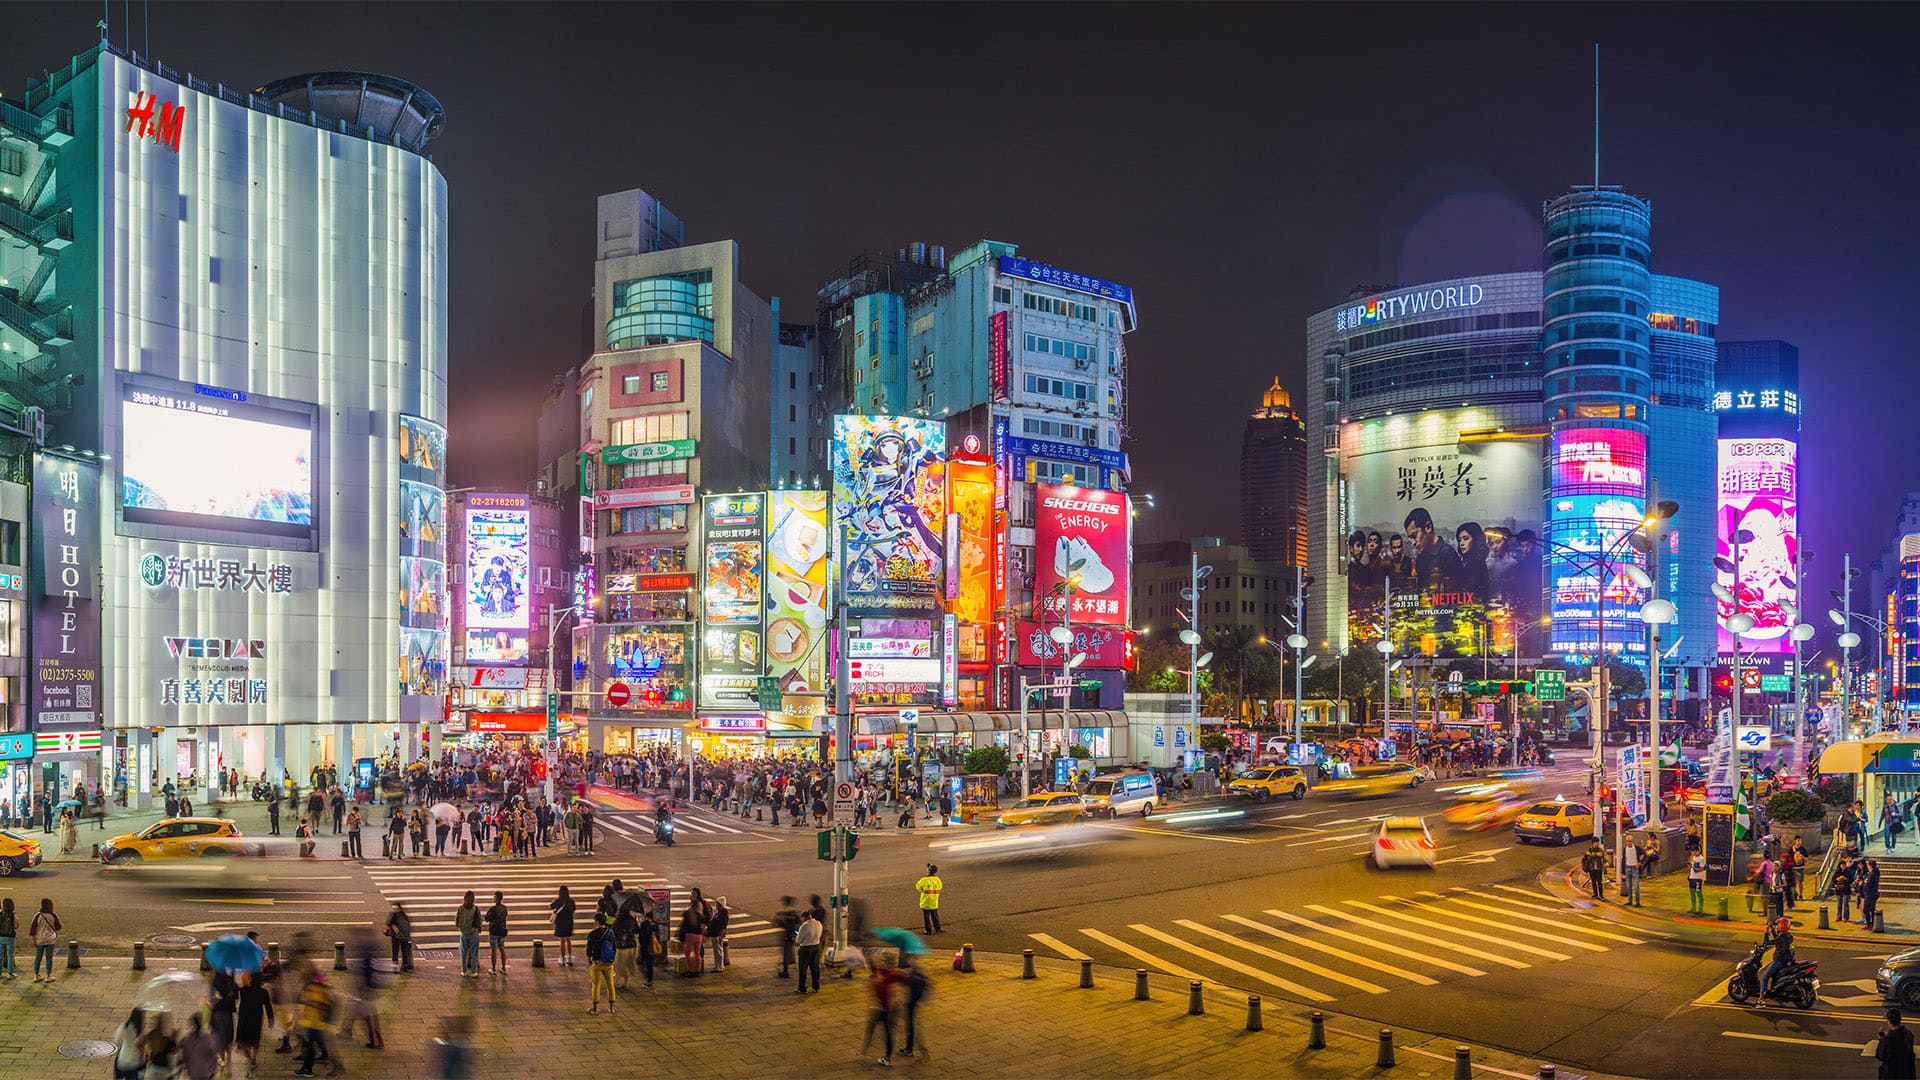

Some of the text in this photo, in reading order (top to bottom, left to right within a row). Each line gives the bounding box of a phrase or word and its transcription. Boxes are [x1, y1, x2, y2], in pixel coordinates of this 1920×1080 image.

[127, 90, 185, 153] H&M
[1042, 266, 1100, 290] 台北天禾旅店
[195, 383, 248, 402] Panasonic
[1713, 389, 1780, 410] 德立莊
[175, 400, 197, 412] 11.8
[1041, 443, 1090, 458] 台北天禾旅店
[1408, 456, 1434, 464] NETFLIX
[1396, 461, 1474, 502] 罪夢者
[59, 470, 80, 537] 明日
[470, 497, 526, 507] 02-27182099
[1043, 497, 1121, 516] SKECHERS
[1060, 514, 1109, 533] ENERGY
[166, 555, 293, 594] 新世界大樓
[60, 544, 80, 654] HOTEL
[1073, 597, 1119, 614] 永不退潮
[1431, 592, 1475, 606] NETFLIX
[1415, 608, 1455, 616] NETFLIX.COM
[163, 635, 265, 659] WESTAR
[39, 667, 95, 683] (02)2375-5500
[43, 685, 71, 695] facebook
[160, 677, 268, 704] 真善美劇院
[1870, 750, 1880, 769] 1
